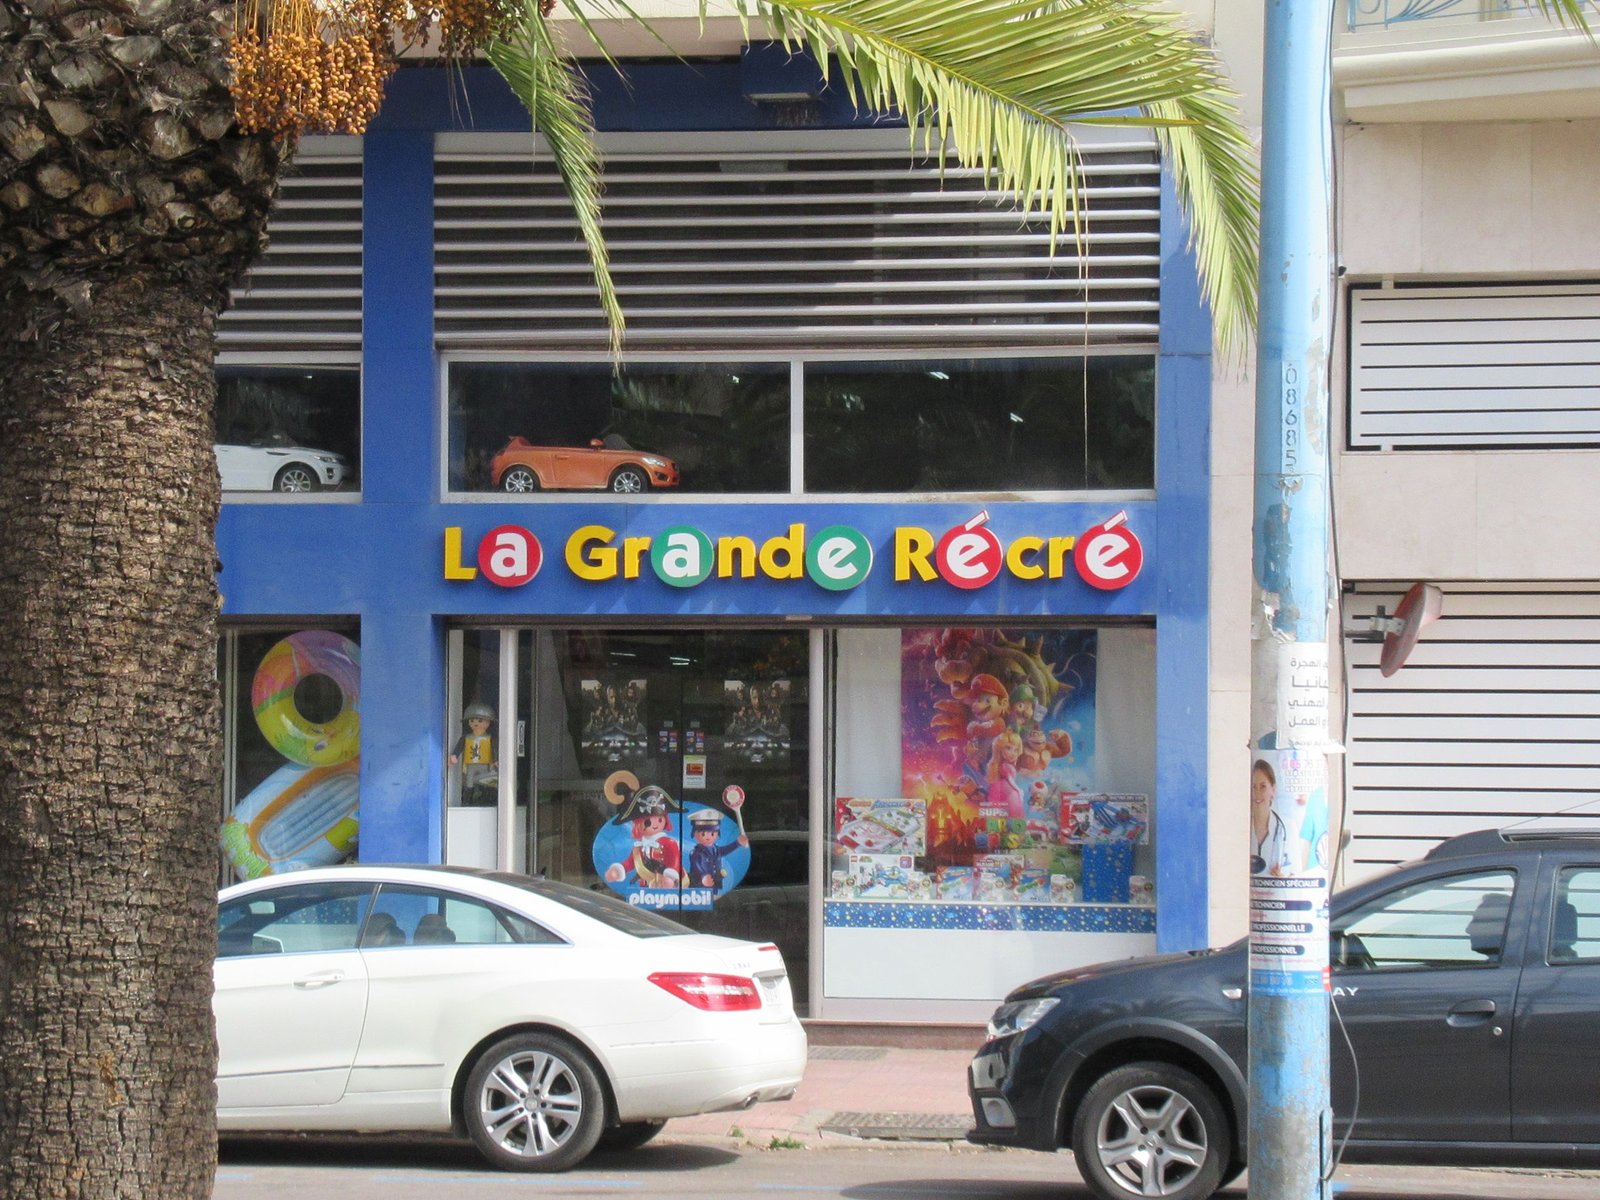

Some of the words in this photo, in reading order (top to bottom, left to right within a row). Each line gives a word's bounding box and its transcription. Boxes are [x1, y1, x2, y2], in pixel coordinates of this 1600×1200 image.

[1285, 367, 1298, 466] 08685
[443, 524, 540, 584] La
[565, 523, 866, 584] Grande
[894, 510, 1137, 585] Récré
[629, 889, 712, 909] playmobil
